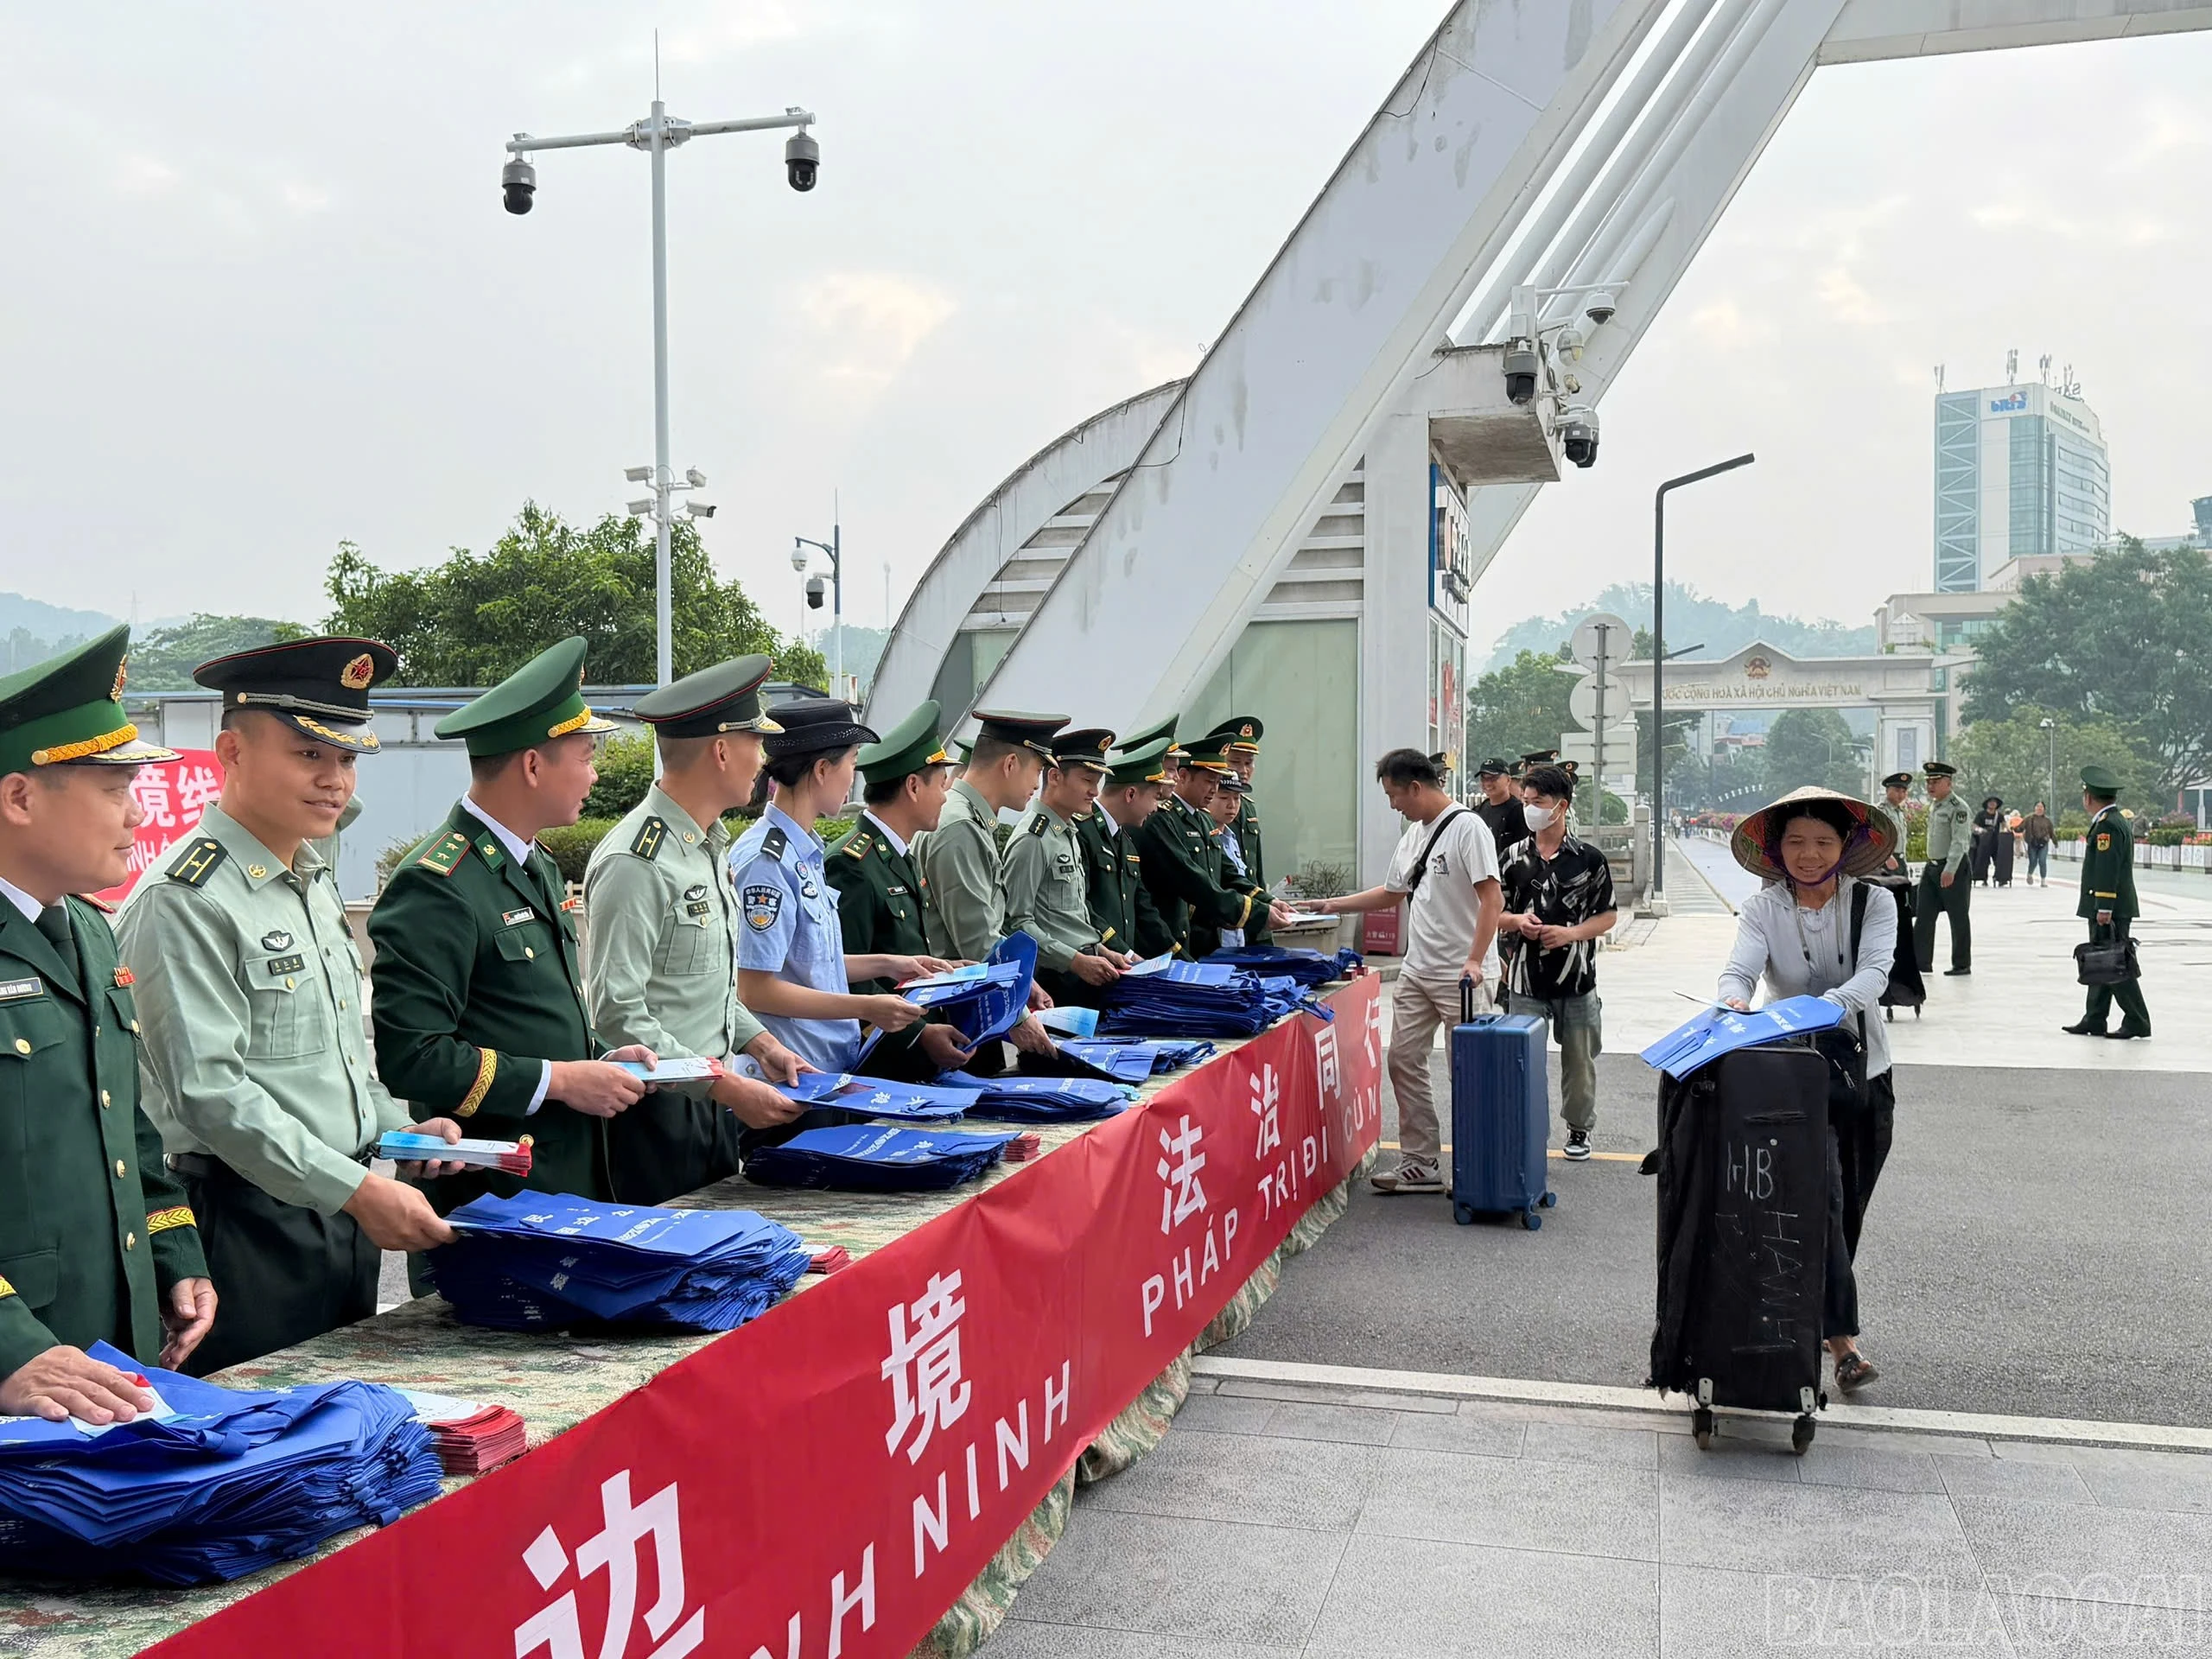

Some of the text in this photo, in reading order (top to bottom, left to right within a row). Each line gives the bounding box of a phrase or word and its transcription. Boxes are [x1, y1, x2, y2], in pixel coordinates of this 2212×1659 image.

[912, 1359, 1070, 1580] NINH
[1141, 1208, 1237, 1338] PHÁP
[1258, 1150, 1297, 1221] TRỊ
[1303, 1126, 1328, 1178] ĐI
